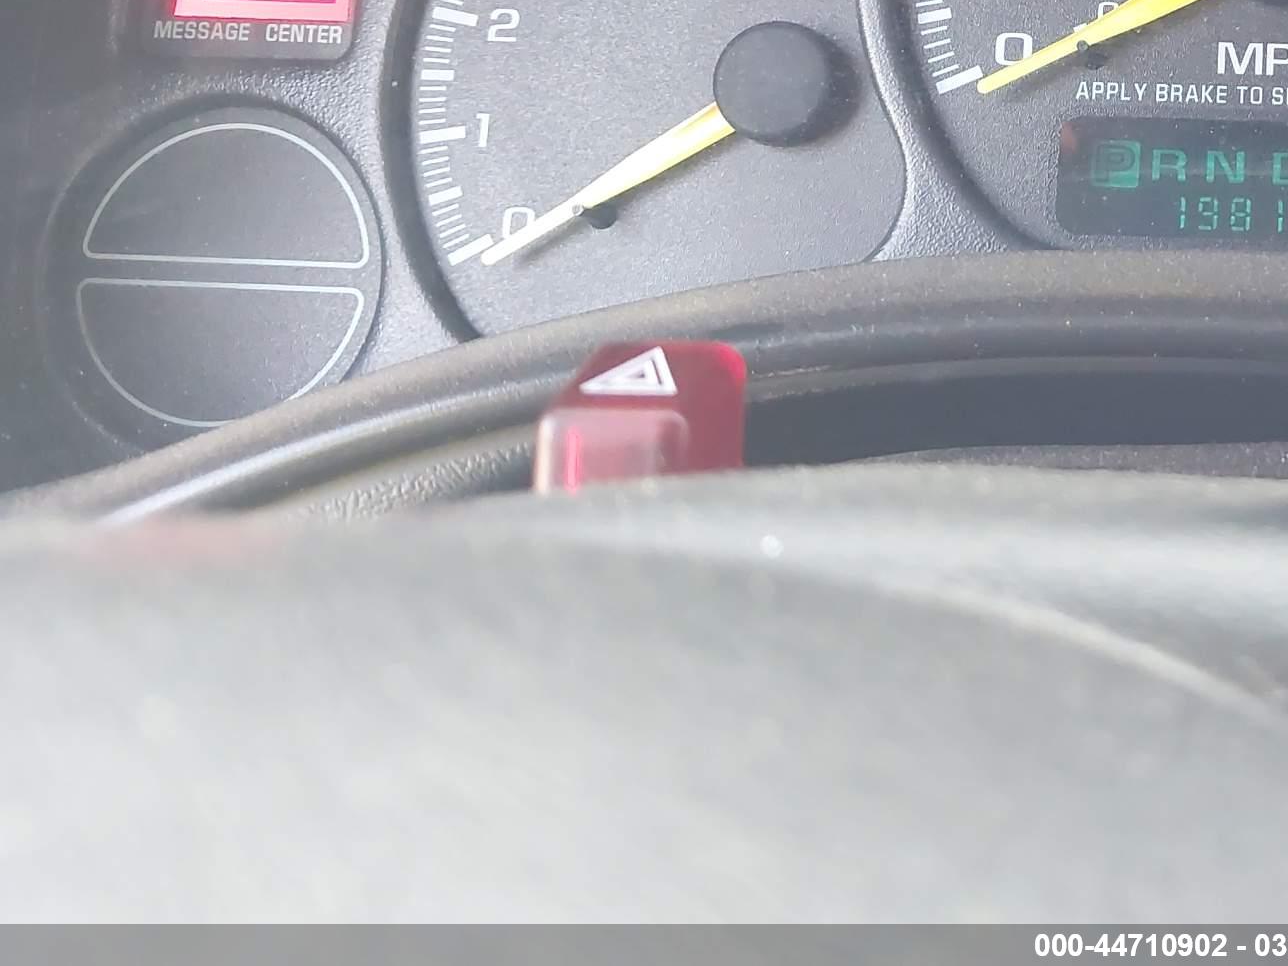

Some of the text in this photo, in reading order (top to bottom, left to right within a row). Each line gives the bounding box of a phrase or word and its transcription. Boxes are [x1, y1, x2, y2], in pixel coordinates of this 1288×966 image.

[154, 21, 343, 44] MESSAGE CENTER
[488, 10, 519, 42] 2
[995, 33, 1033, 66] 0
[1076, 81, 1148, 102] APPLY
[1155, 84, 1228, 104] BRAKE
[1236, 86, 1264, 105] TO
[477, 113, 489, 146] 1
